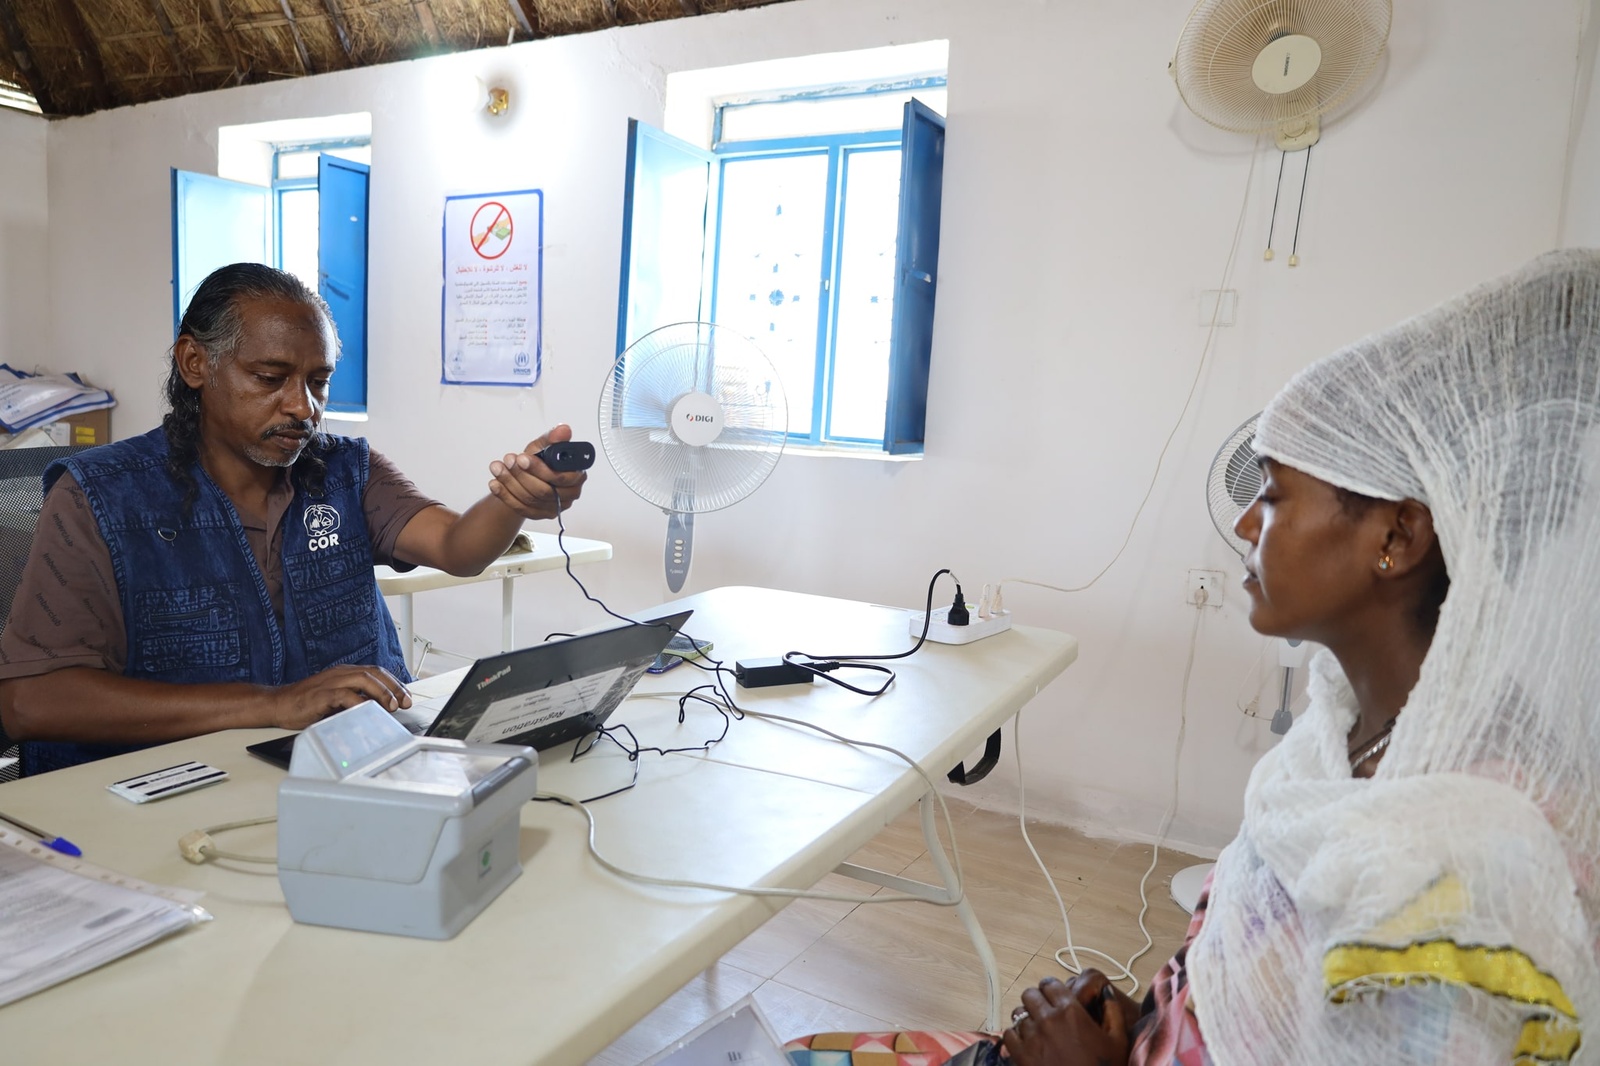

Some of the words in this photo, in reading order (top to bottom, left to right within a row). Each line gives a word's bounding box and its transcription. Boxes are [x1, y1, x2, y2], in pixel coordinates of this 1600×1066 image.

[695, 414, 714, 423] DIGI
[308, 533, 340, 552] COR
[476, 665, 512, 691] ThinkPad
[502, 710, 566, 734] Registration
